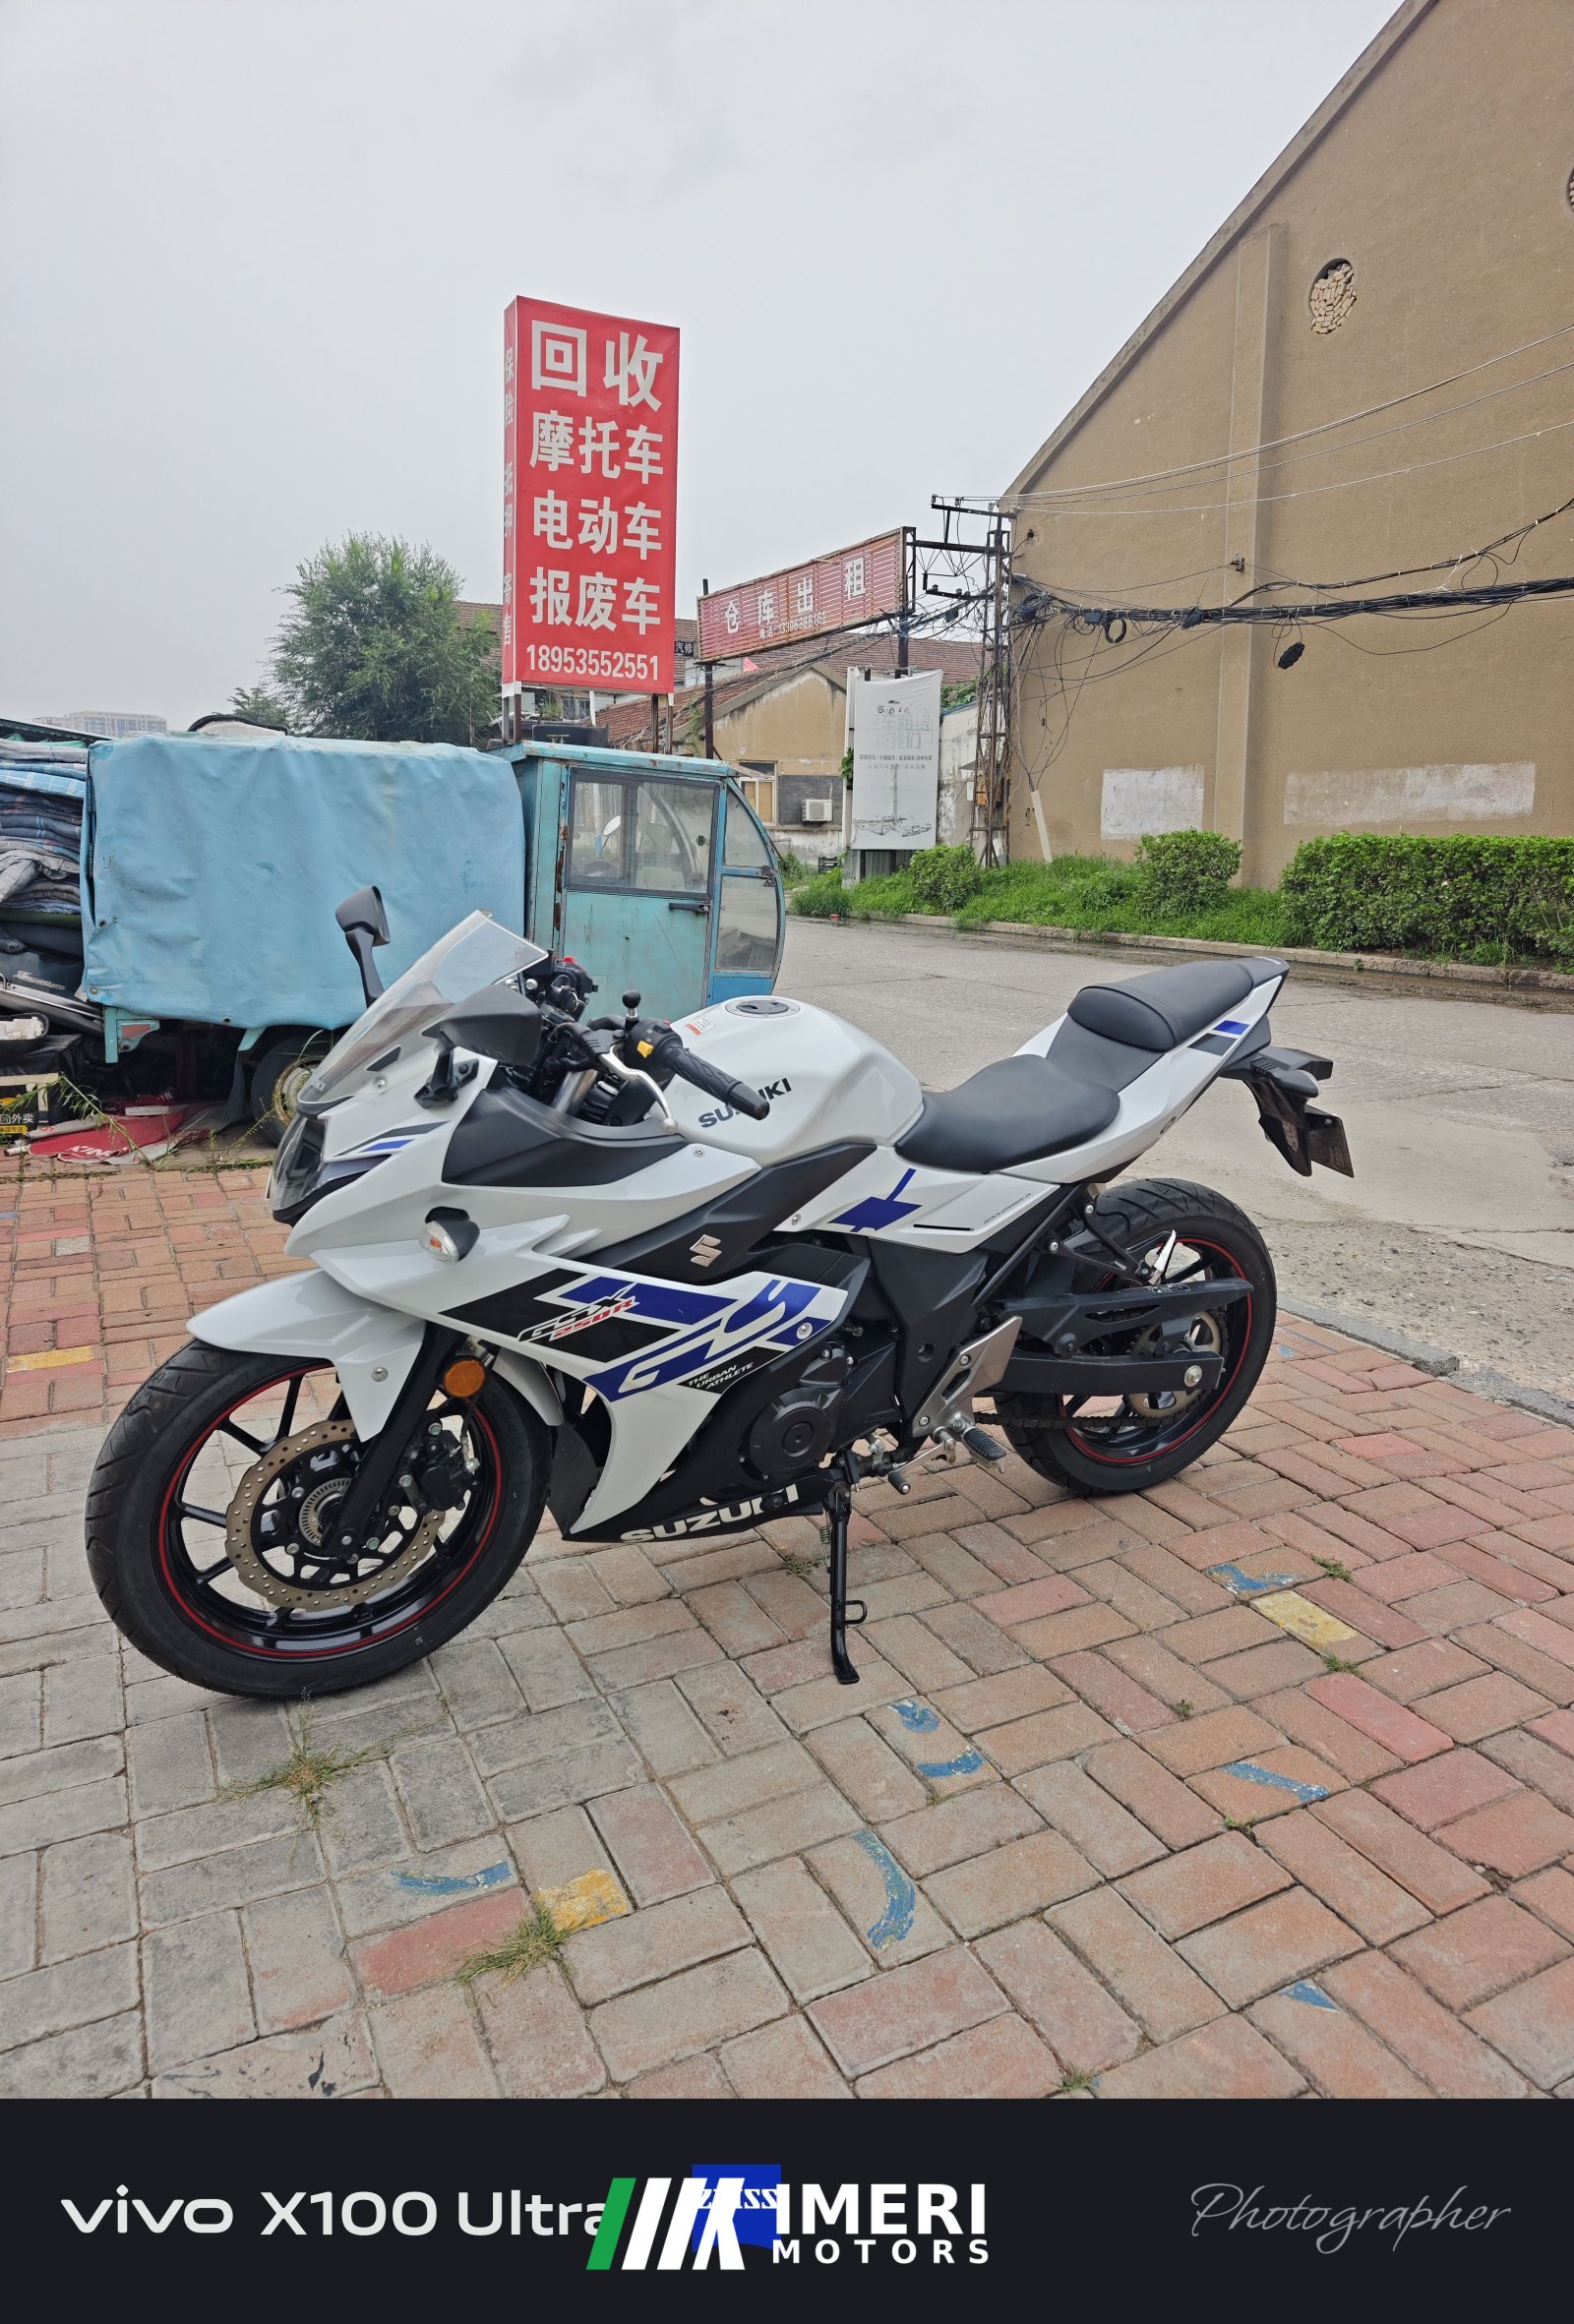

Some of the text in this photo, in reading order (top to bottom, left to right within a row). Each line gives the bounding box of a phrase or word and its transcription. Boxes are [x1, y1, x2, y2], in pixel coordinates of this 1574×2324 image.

[531, 320, 664, 413] 回收
[529, 409, 664, 485] 摩托车
[533, 489, 663, 562] 电动车
[529, 566, 661, 635] 报废车
[724, 556, 866, 634] 仓库出租
[526, 644, 659, 681] 18953552551
[697, 1078, 792, 1128] SUKI
[688, 1372, 710, 1386] THE
[696, 1365, 737, 1388] URBAN
[706, 1361, 754, 1389] ATHLETE
